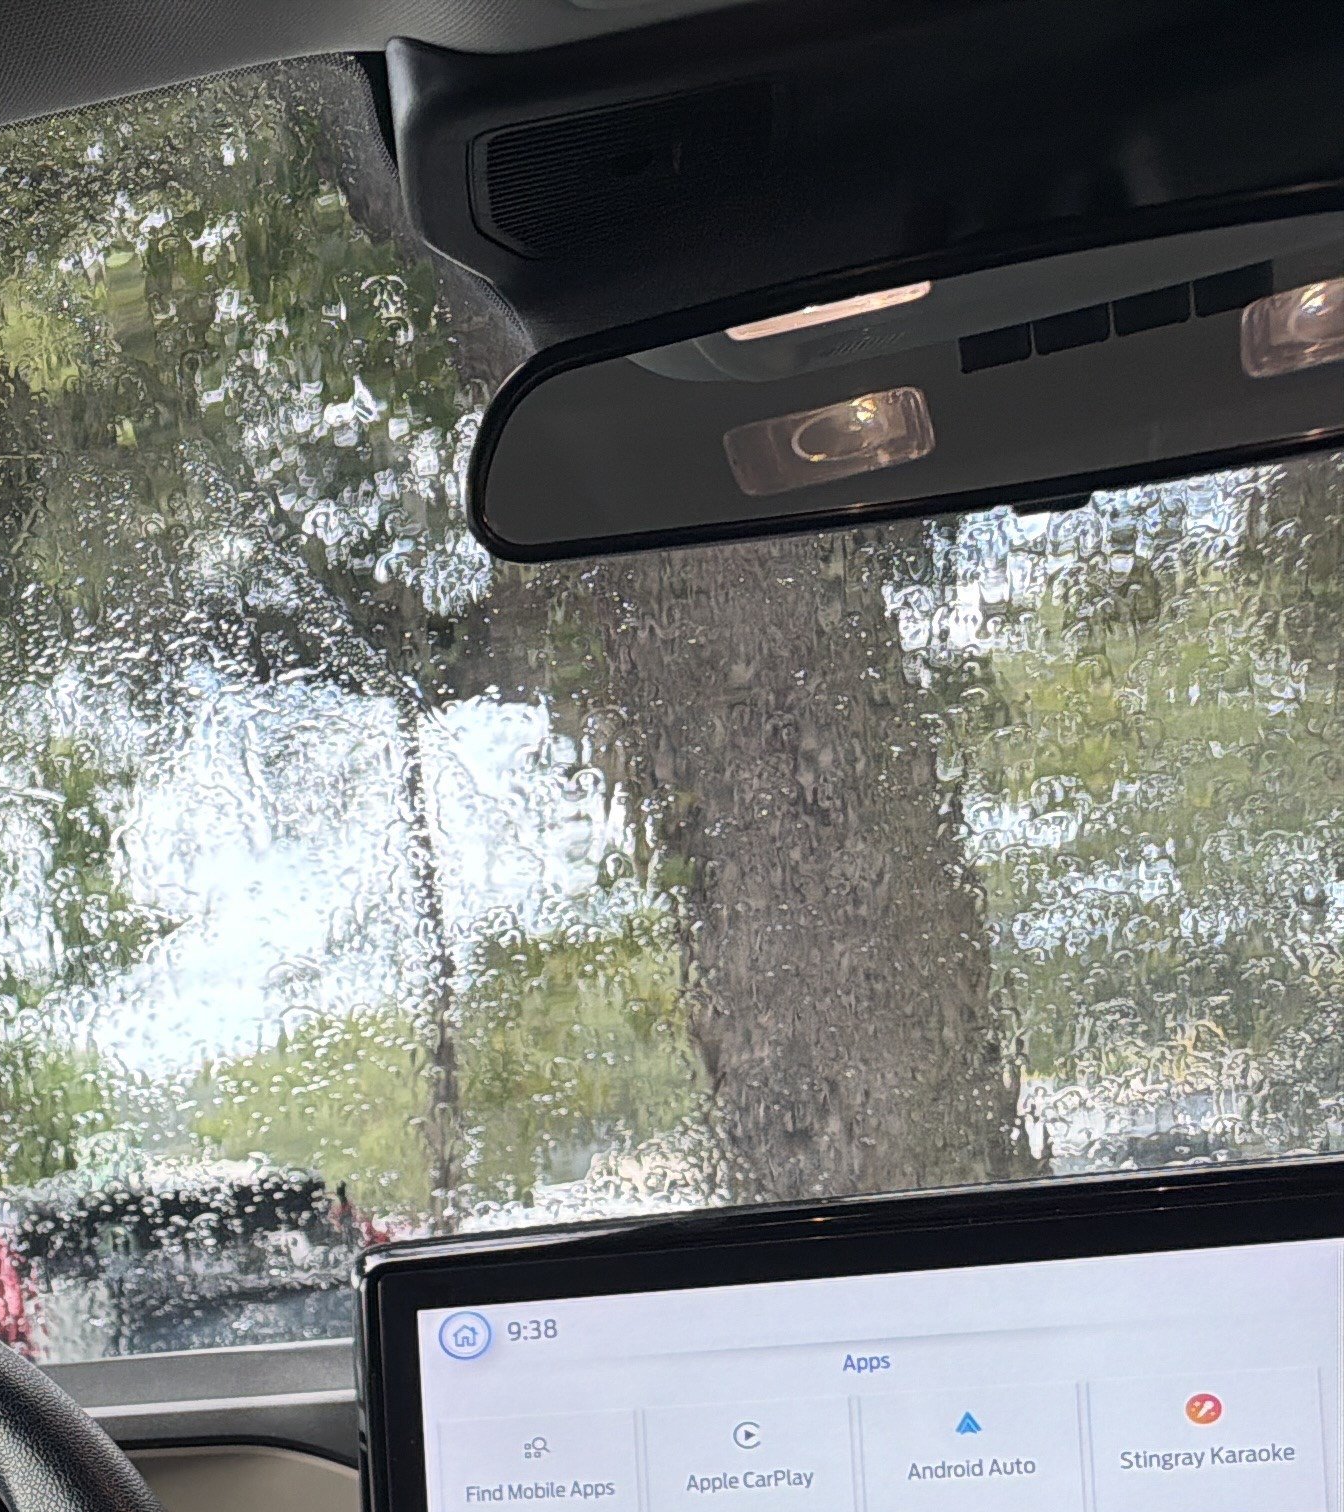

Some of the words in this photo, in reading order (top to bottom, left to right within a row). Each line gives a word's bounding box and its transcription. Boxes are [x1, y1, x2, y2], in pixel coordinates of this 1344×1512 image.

[507, 1319, 558, 1340] 9:38
[843, 1352, 891, 1373] Apps
[1120, 1448, 1205, 1473] Stingray
[1211, 1443, 1296, 1466] Karaoke
[907, 1460, 983, 1481] Android
[989, 1458, 1036, 1477] Auto
[466, 1484, 504, 1502] Find
[508, 1482, 566, 1500] Mobile
[570, 1480, 616, 1500] Apps
[686, 1471, 739, 1494] Apple
[743, 1470, 814, 1489] CarPlay
